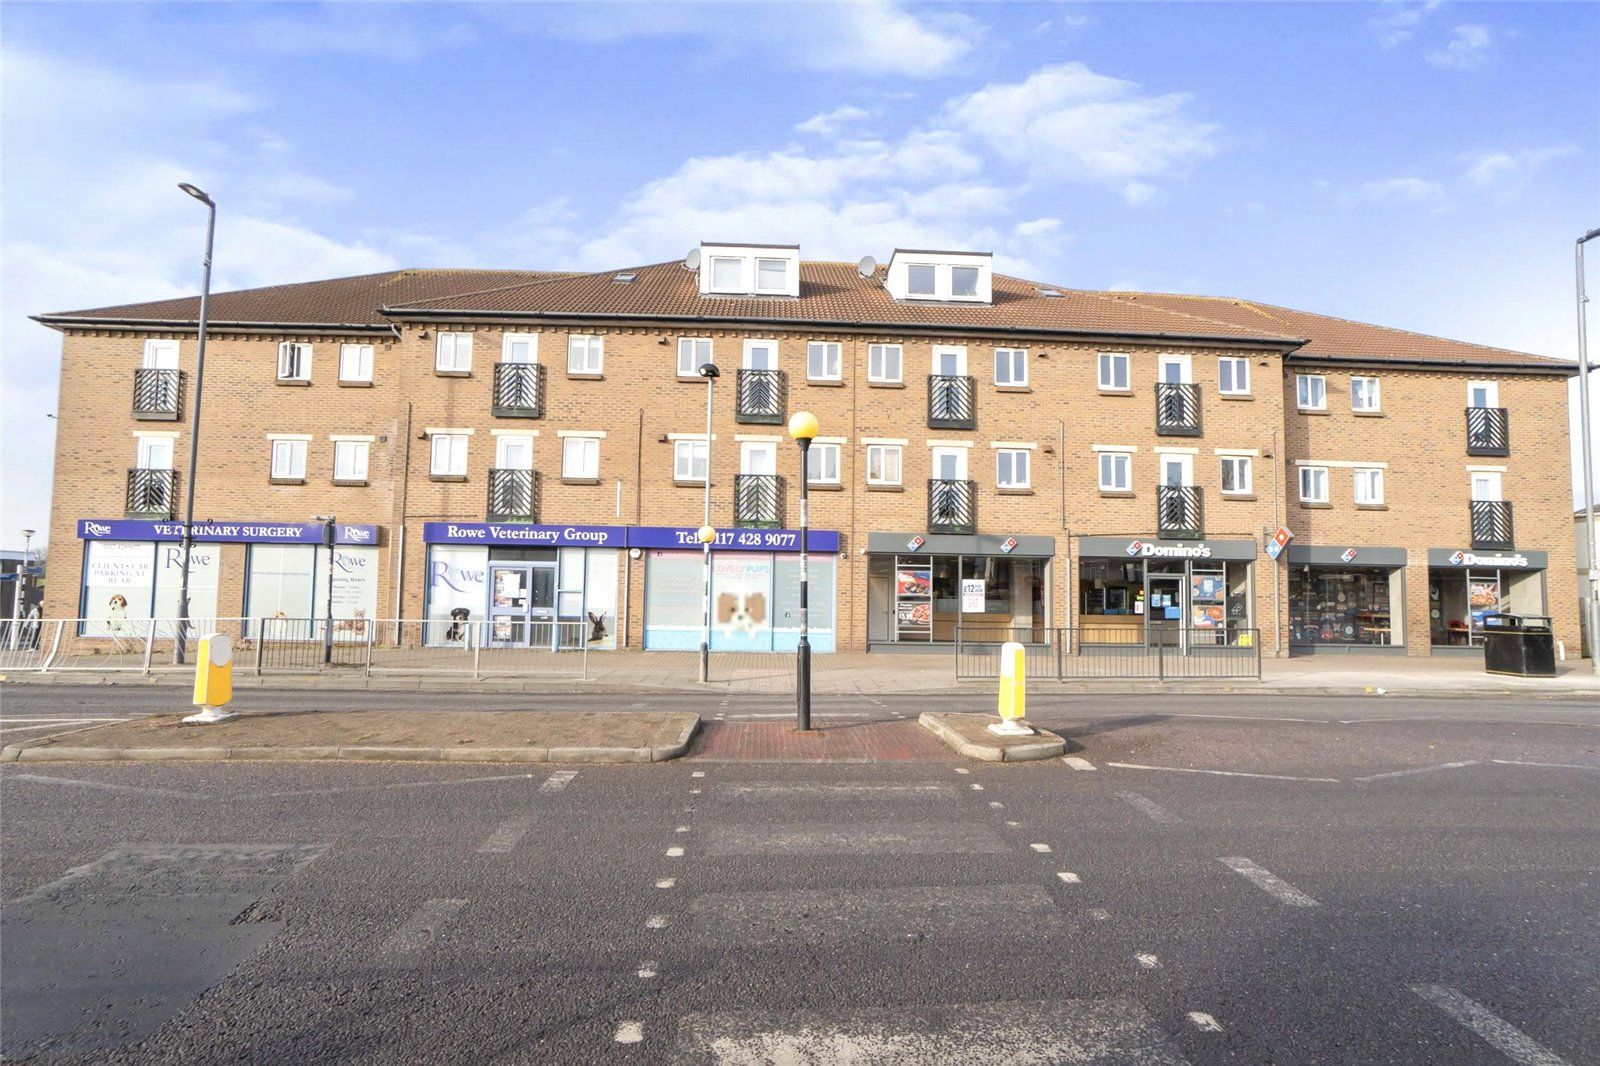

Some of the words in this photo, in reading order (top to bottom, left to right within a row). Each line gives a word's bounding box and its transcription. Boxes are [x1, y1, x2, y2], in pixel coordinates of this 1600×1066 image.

[84, 521, 111, 536] Rowe
[153, 524, 240, 536] VETRINARY
[242, 526, 304, 537] SURGERY
[344, 526, 370, 541] Rowe
[447, 525, 486, 538] Rowe
[489, 526, 560, 544] Veterinary
[564, 527, 608, 545] Group
[710, 532, 735, 545] 117
[738, 533, 761, 545] 428
[764, 533, 796, 546] 9077
[1141, 543, 1211, 557] Domino's
[165, 547, 210, 573] Rwe
[1463, 553, 1528, 567] Domino's
[431, 561, 485, 593] Rwe
